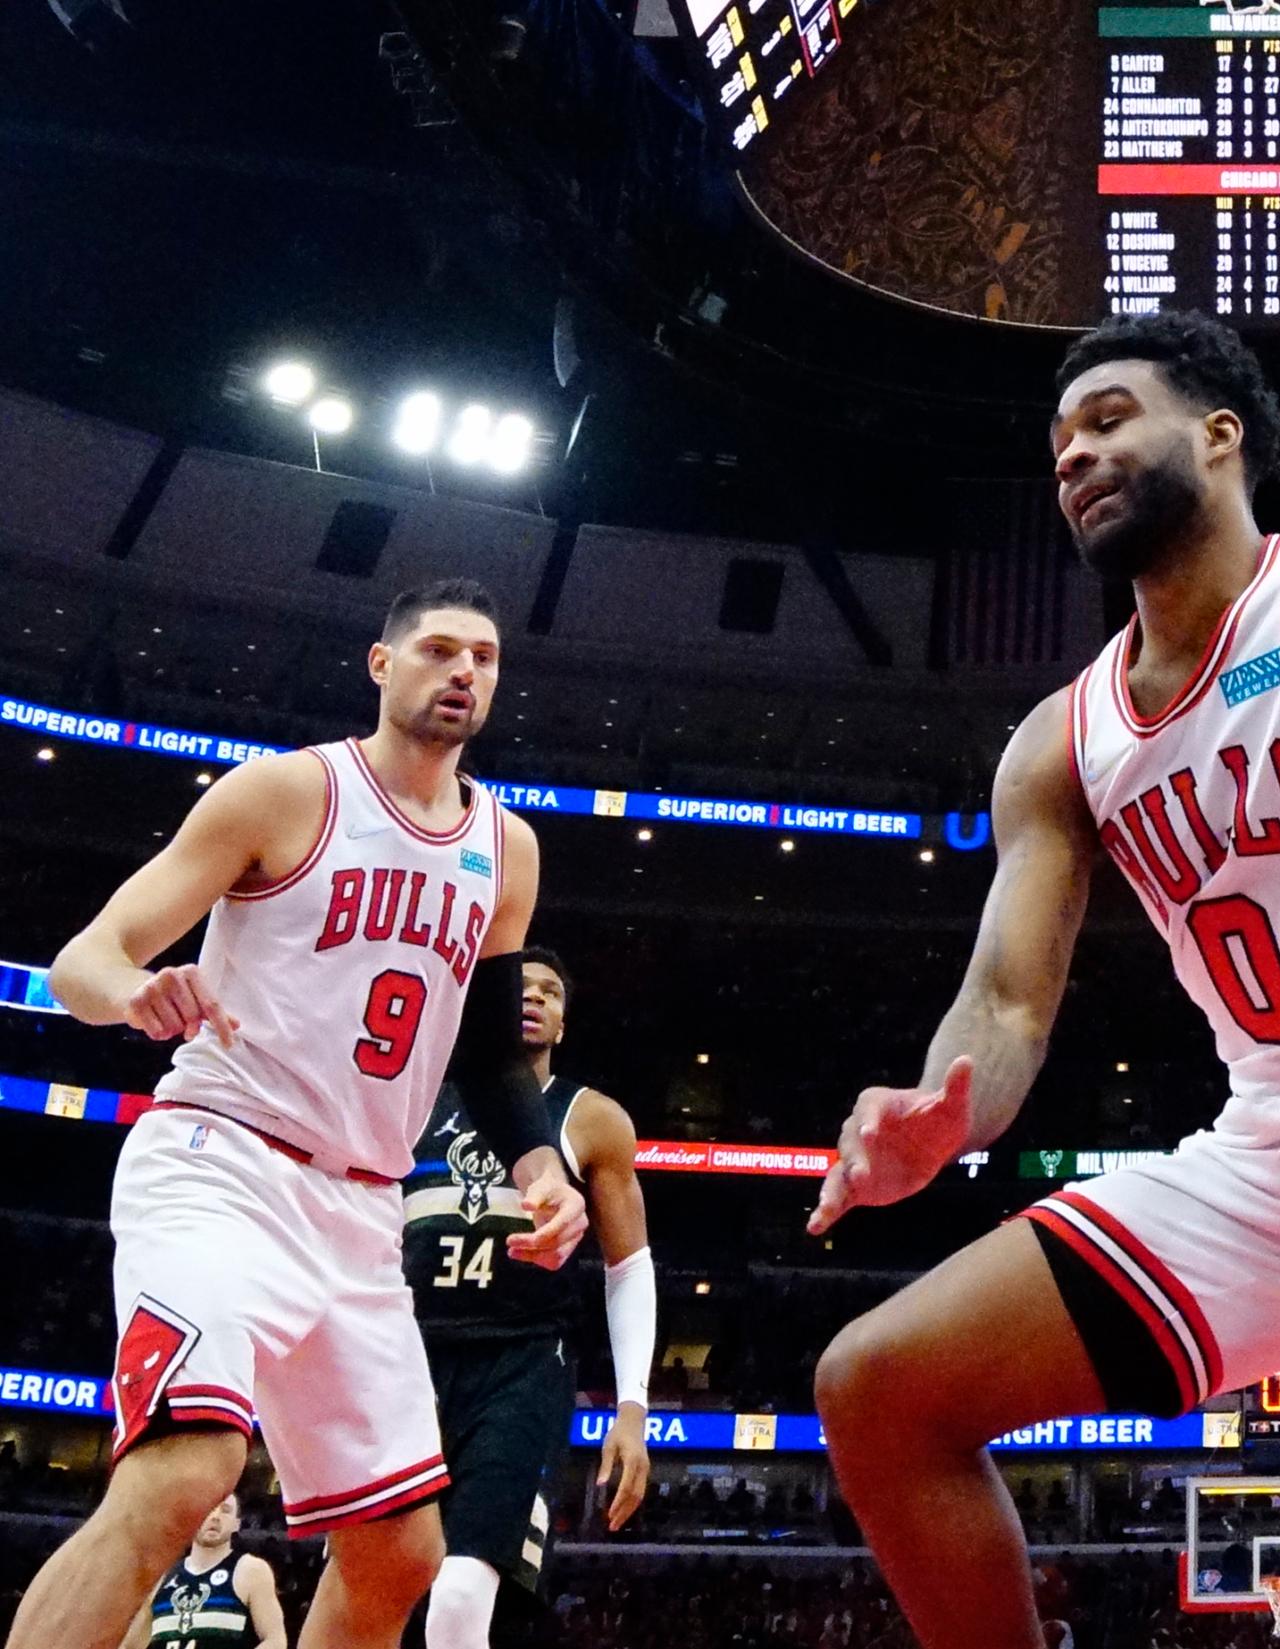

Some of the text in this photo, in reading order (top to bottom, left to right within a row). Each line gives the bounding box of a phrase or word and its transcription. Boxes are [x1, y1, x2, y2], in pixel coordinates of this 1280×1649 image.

[1264, 40, 1280, 52] PTS
[1122, 55, 1164, 72] CARTER
[1218, 55, 1230, 72] 17
[1244, 56, 1252, 72] 4
[1111, 77, 1119, 93] 7
[1122, 77, 1155, 93] ALLEN
[1264, 77, 1279, 93] 27
[1104, 98, 1119, 115] 24
[1221, 172, 1277, 188] CHICAGO
[1264, 197, 1280, 209] PTS
[1122, 212, 1157, 229] WHITE
[1245, 213, 1251, 228] 1
[1267, 212, 1276, 229] 2
[1107, 234, 1119, 250] 12
[1245, 234, 1251, 250] 1
[1245, 255, 1251, 271] 1
[1266, 255, 1277, 271] 11
[1104, 276, 1120, 292] 44
[1122, 276, 1175, 293] WILLIAMS
[1244, 276, 1252, 292] 4
[1265, 276, 1278, 292] 17
[1245, 298, 1251, 313] 1
[1, 700, 120, 742] SUPERIOR
[139, 728, 212, 756] LIGHT
[657, 798, 908, 835] SUPERIOR LIGHT BEER
[314, 868, 486, 988] BULLS
[353, 969, 427, 1081] 9
[634, 1146, 829, 1171] udweiser CHAMPIONS CLUB
[1077, 1152, 1163, 1175] MILWAU
[433, 1236, 494, 1288] 34
[0, 1373, 97, 1408] ERIOR
[581, 1416, 688, 1442] URA
[1080, 1419, 1153, 1445] BEER
